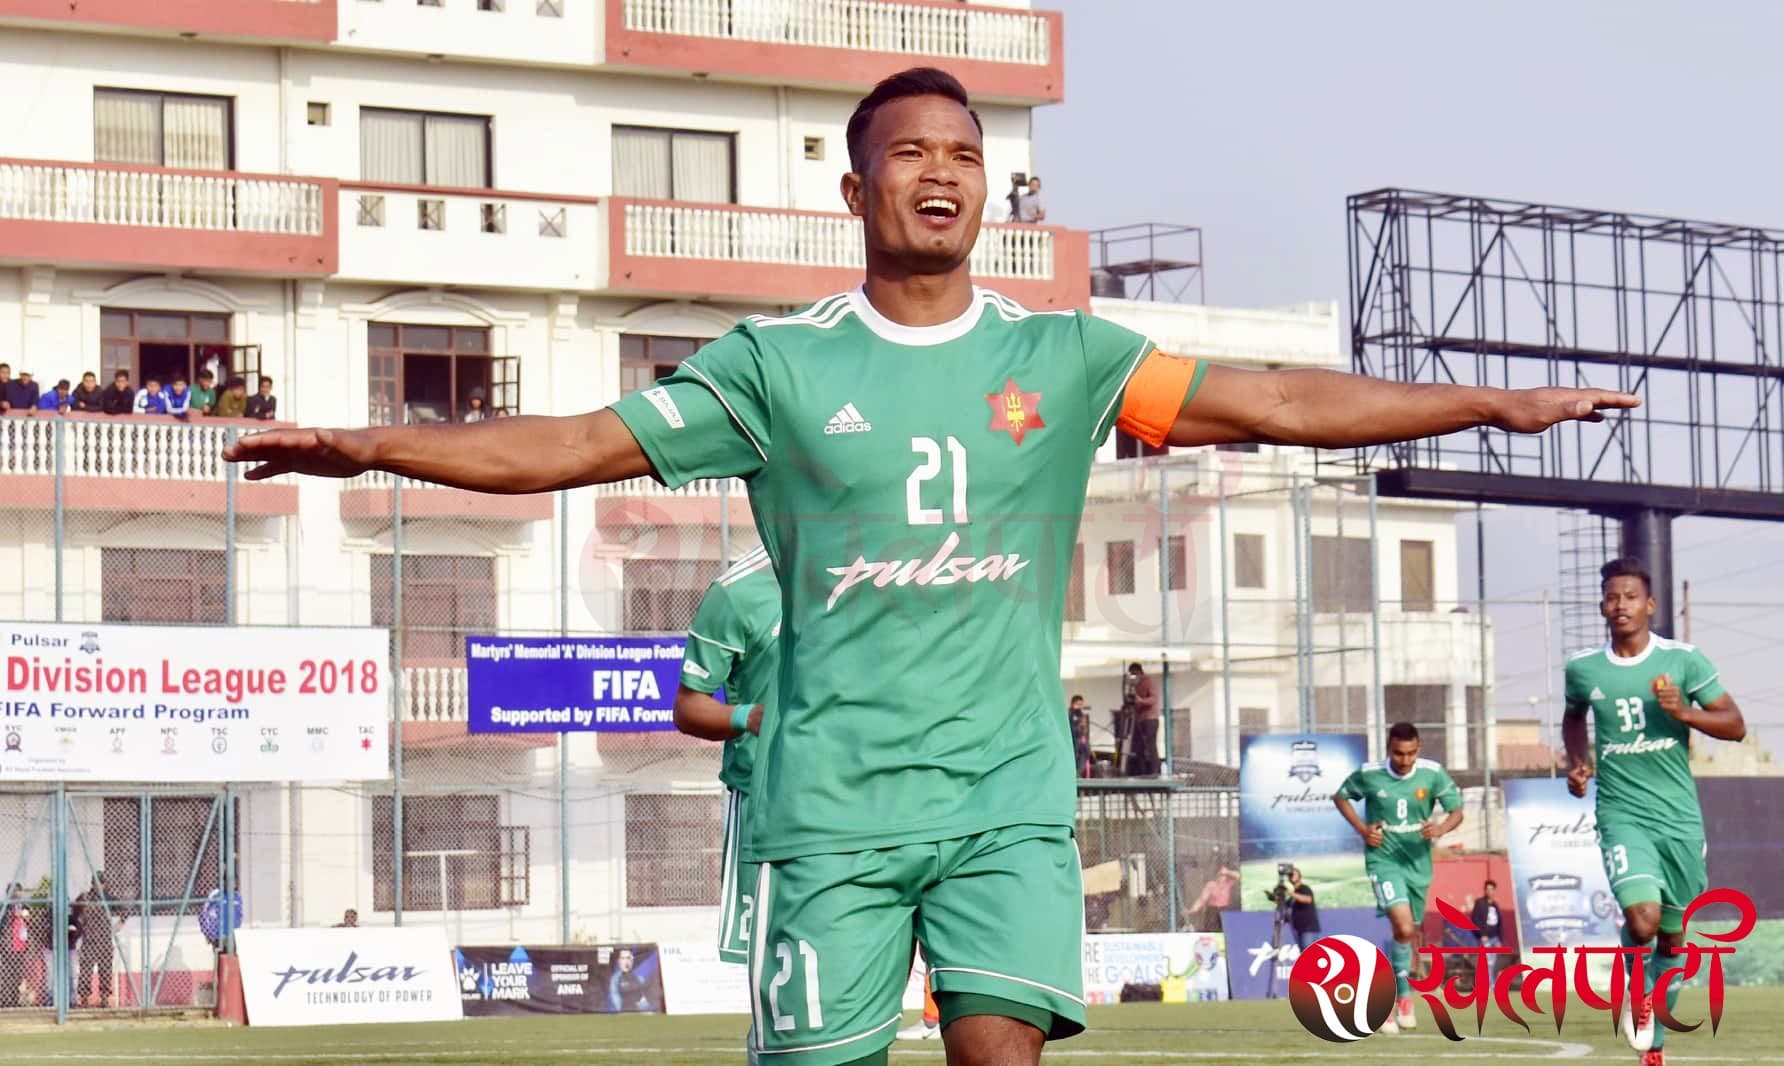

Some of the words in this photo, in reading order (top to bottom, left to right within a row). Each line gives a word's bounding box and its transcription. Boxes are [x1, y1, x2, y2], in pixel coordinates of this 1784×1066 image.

[824, 421, 872, 435] adidas
[906, 436, 968, 525] 21
[826, 531, 1031, 612] pulsar
[11, 633, 70, 648] Pulsar
[471, 643, 513, 662] Martyrs'
[514, 643, 560, 660] Memorial
[576, 644, 615, 660] Division
[616, 644, 652, 662] League
[7, 656, 147, 694] Division
[161, 658, 287, 703] League
[299, 658, 378, 694] 2018
[592, 670, 661, 700] FIFA
[51, 702, 145, 719] Forward
[154, 704, 250, 722] Program
[491, 706, 570, 725] Supported
[574, 706, 592, 726] by
[596, 707, 631, 722] FIFA
[1615, 696, 1647, 732] 33
[1397, 798, 1408, 819] 8
[1528, 813, 1593, 844] puls
[1382, 881, 1395, 900] 8
[272, 950, 428, 999] pulsar
[491, 962, 533, 975] LEAVE
[493, 975, 527, 987] YOUR
[557, 983, 583, 995] ANFA
[769, 940, 824, 1031] 21
[306, 990, 375, 1004] TECHNOLOGY
[379, 990, 390, 1002] OF
[396, 989, 432, 1002] POWER
[491, 987, 531, 999] MARK
